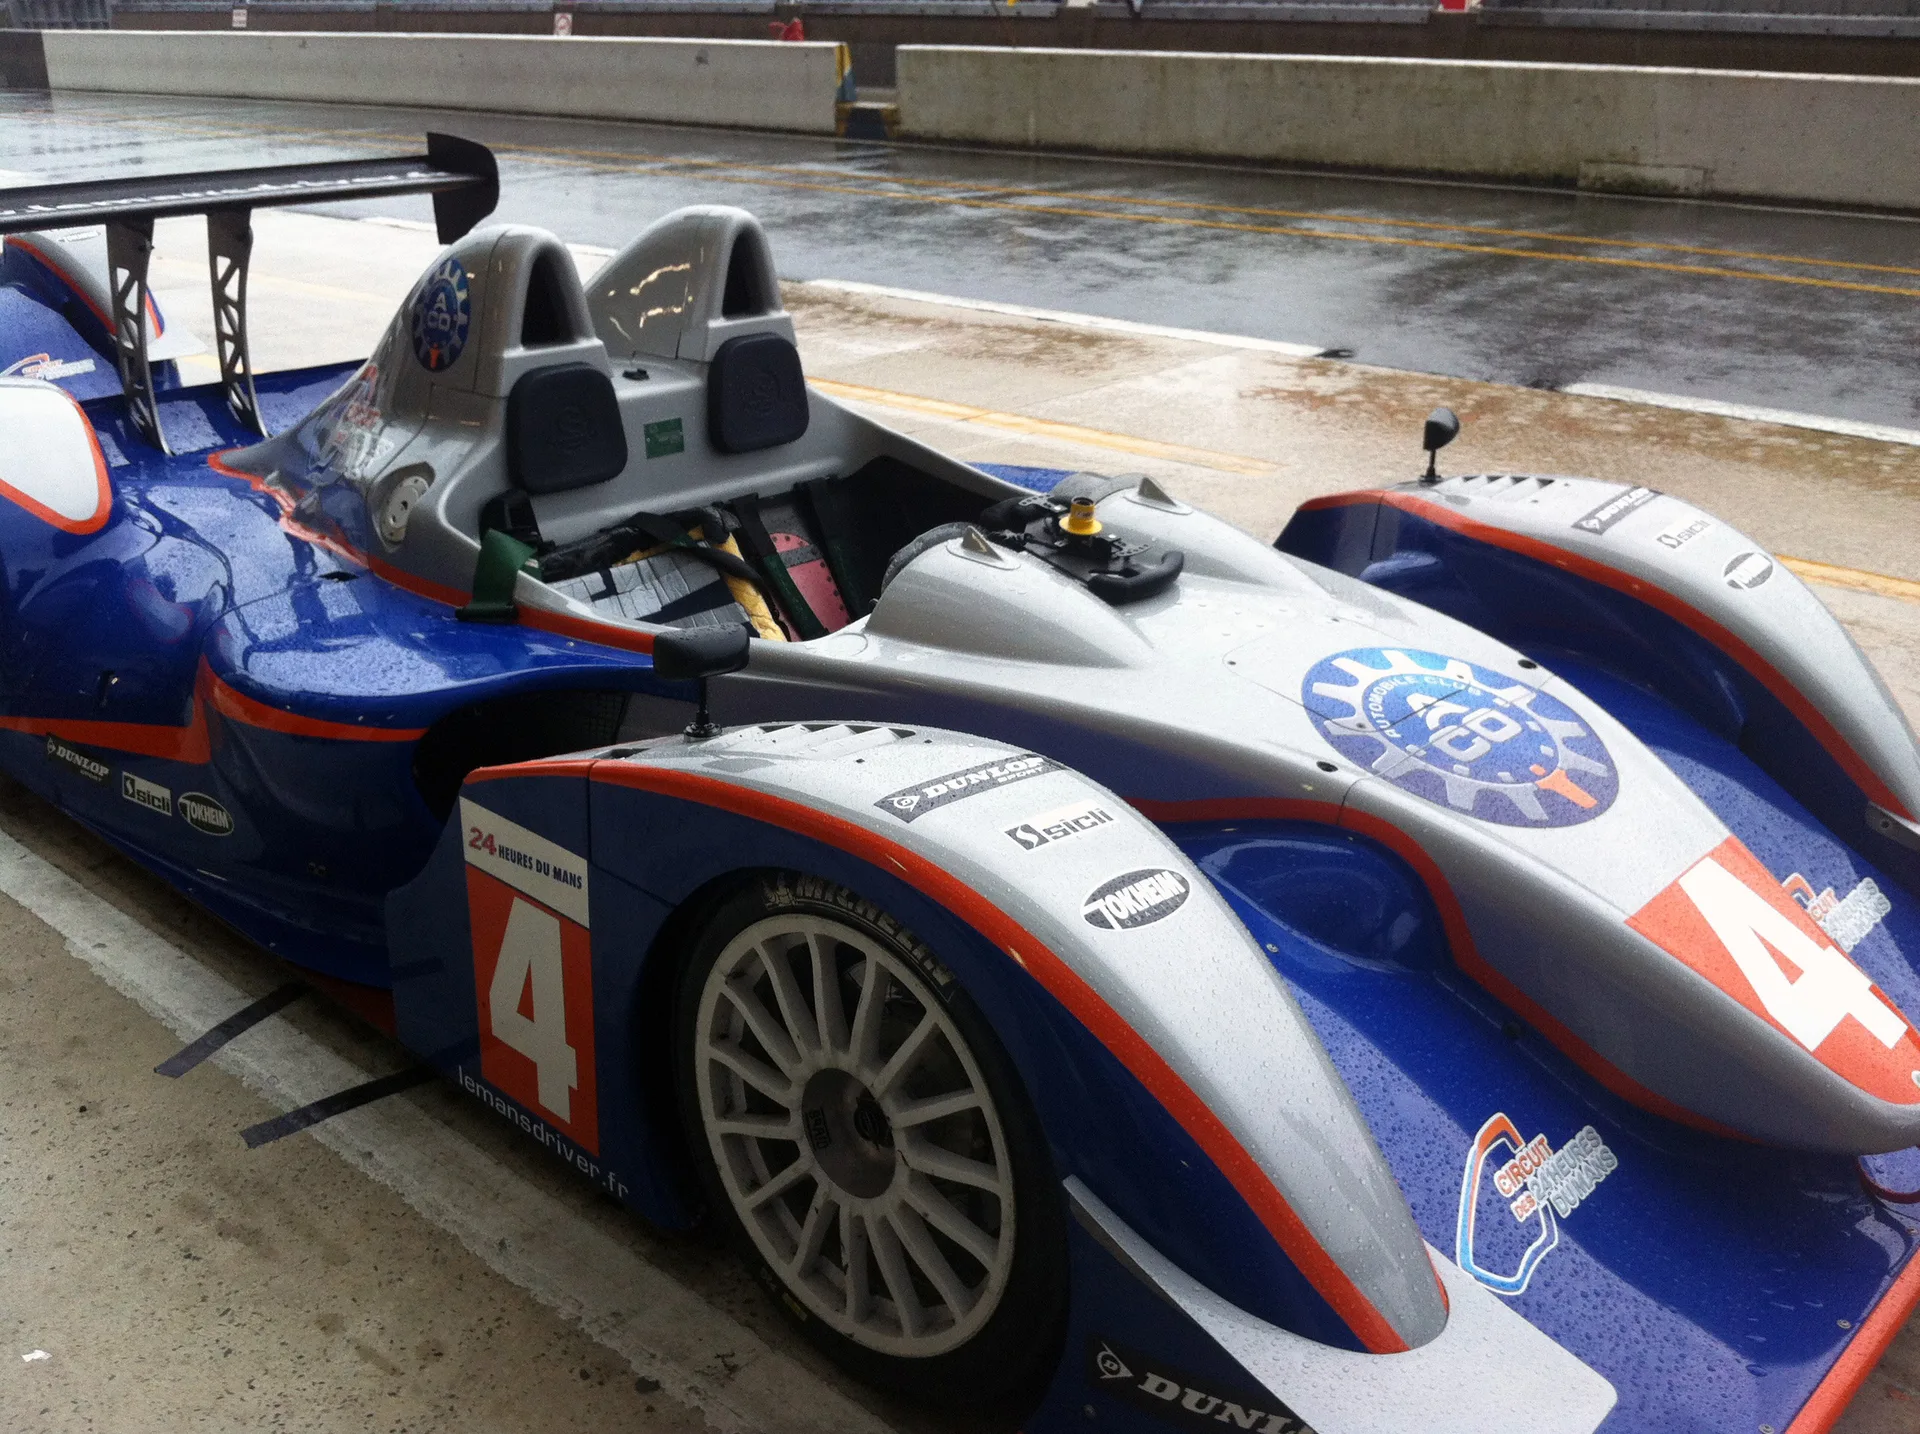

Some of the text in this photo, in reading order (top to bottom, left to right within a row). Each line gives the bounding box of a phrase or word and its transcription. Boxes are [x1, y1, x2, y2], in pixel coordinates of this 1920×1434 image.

[1368, 675, 1482, 739] AUTOMOBILE CLUB
[56, 744, 110, 777] DUNLOP
[921, 757, 1044, 799] DUNLOP
[135, 787, 170, 814] sicli
[178, 798, 229, 829] TOKHEIM
[1042, 807, 1115, 841] sicli
[468, 826, 583, 890] 24 HEURES DU MANS
[1081, 870, 1186, 930] TOKHEIM
[1678, 856, 1909, 1053] 4
[489, 896, 578, 1124] 4
[458, 1064, 630, 1197] lemansdriver.fr
[1495, 1136, 1552, 1193] CIRCUIT
[1513, 1194, 1536, 1218] DES
